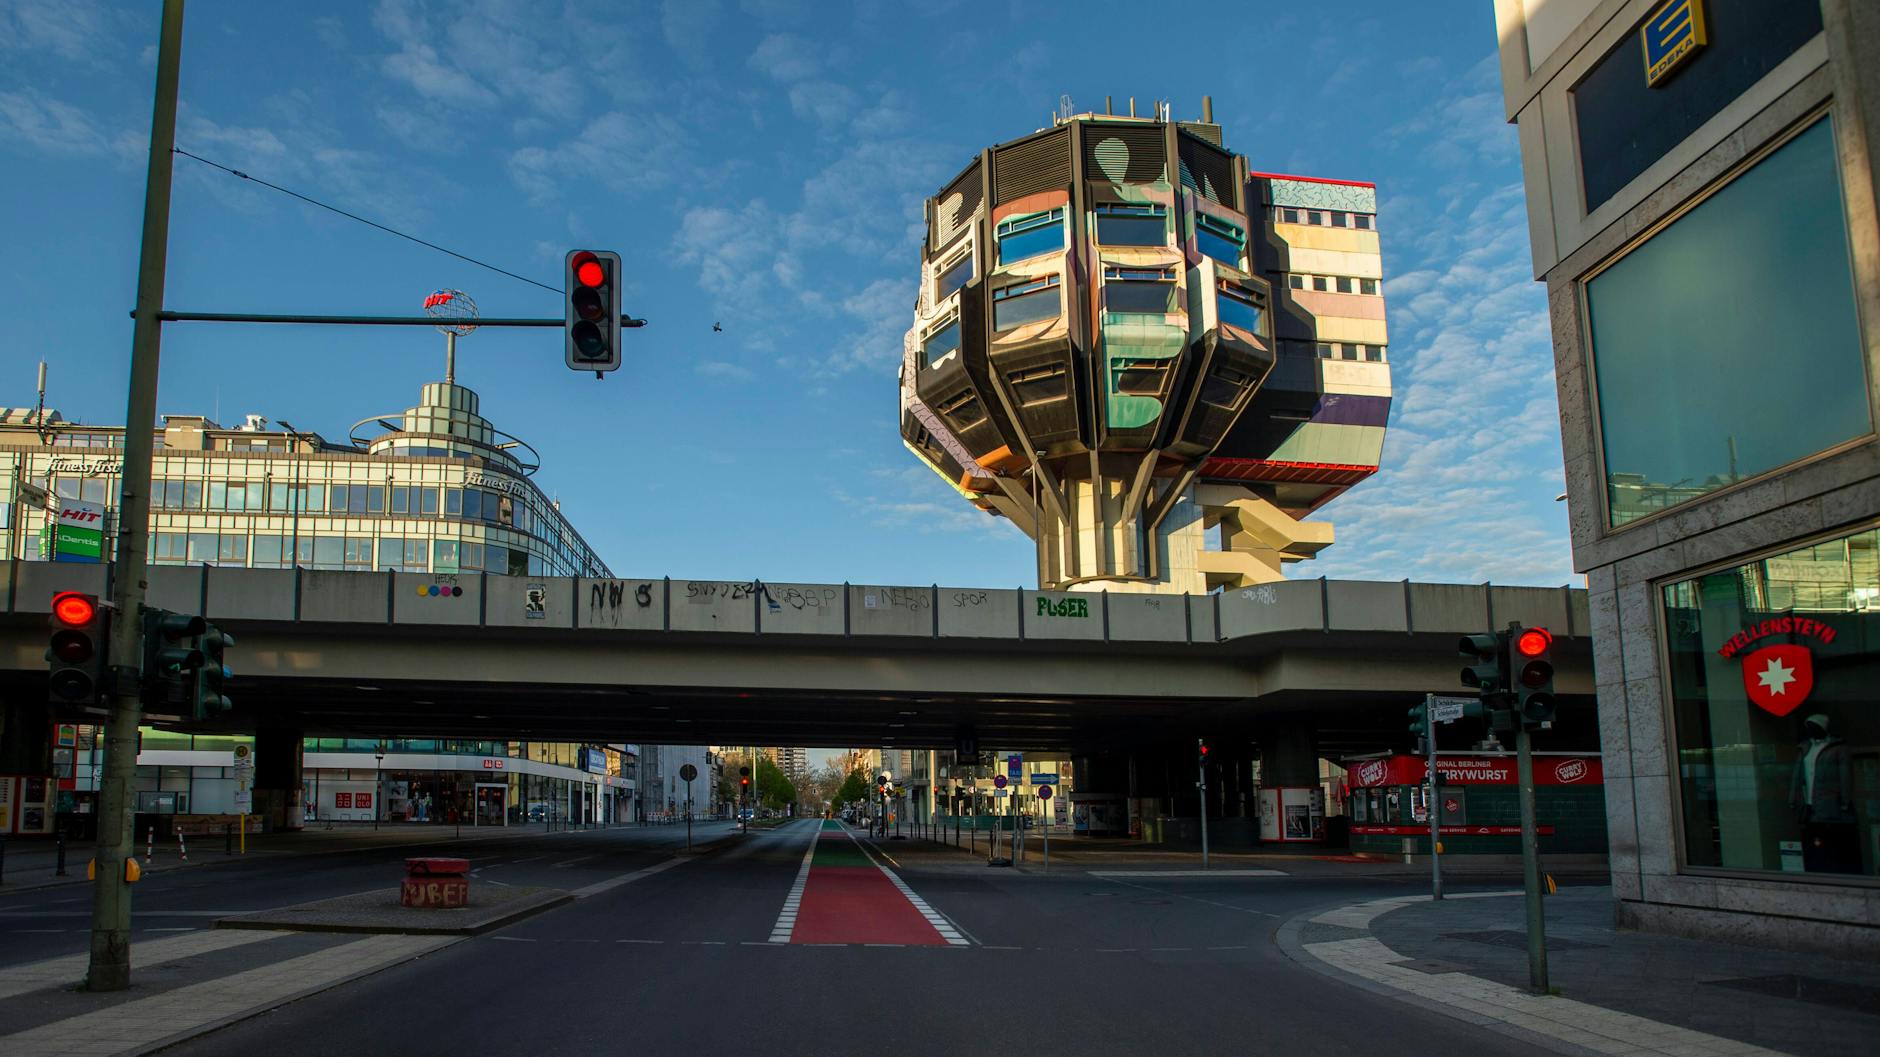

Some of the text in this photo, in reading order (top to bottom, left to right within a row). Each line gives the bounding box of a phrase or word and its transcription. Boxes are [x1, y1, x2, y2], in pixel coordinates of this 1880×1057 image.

[1650, 38, 1693, 80] EDEKA
[61, 507, 102, 523] HIT
[1717, 616, 1838, 658] WELLENSTEYN
[1360, 760, 1382, 777] CURRY
[1424, 760, 1457, 768] OGINAL
[1559, 762, 1582, 775] CURRY
[1363, 769, 1384, 785] WOLF
[1424, 769, 1508, 780] CRRYWURST
[1561, 768, 1582, 779] WOLF
